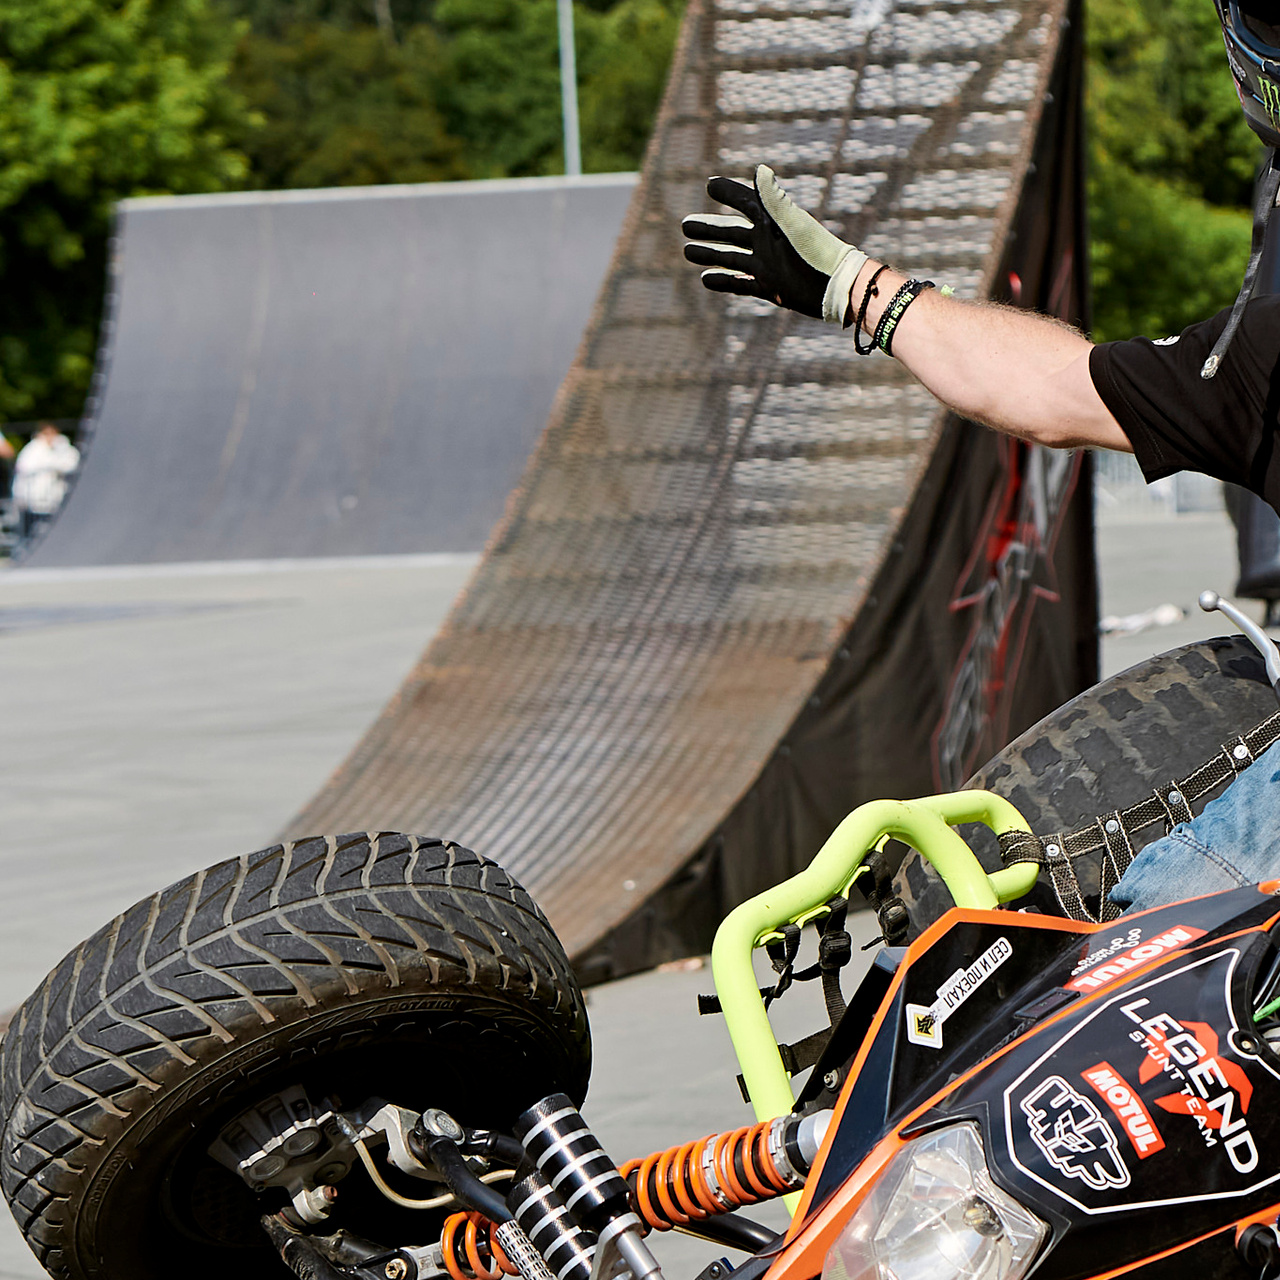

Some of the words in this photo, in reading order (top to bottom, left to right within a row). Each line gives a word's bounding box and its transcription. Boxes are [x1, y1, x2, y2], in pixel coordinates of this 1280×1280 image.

[979, 957, 992, 973] И
[988, 940, 1009, 965] СЕЛ
[1073, 928, 1192, 987] MOTUL
[943, 965, 983, 1009] ПОЕХАЛ
[201, 1037, 277, 1087] ROTATION
[1120, 997, 1259, 1174] LEGEND
[1128, 1029, 1186, 1082] STUNT
[1180, 1082, 1218, 1148] TEAM
[1087, 1068, 1158, 1153] MOTUL
